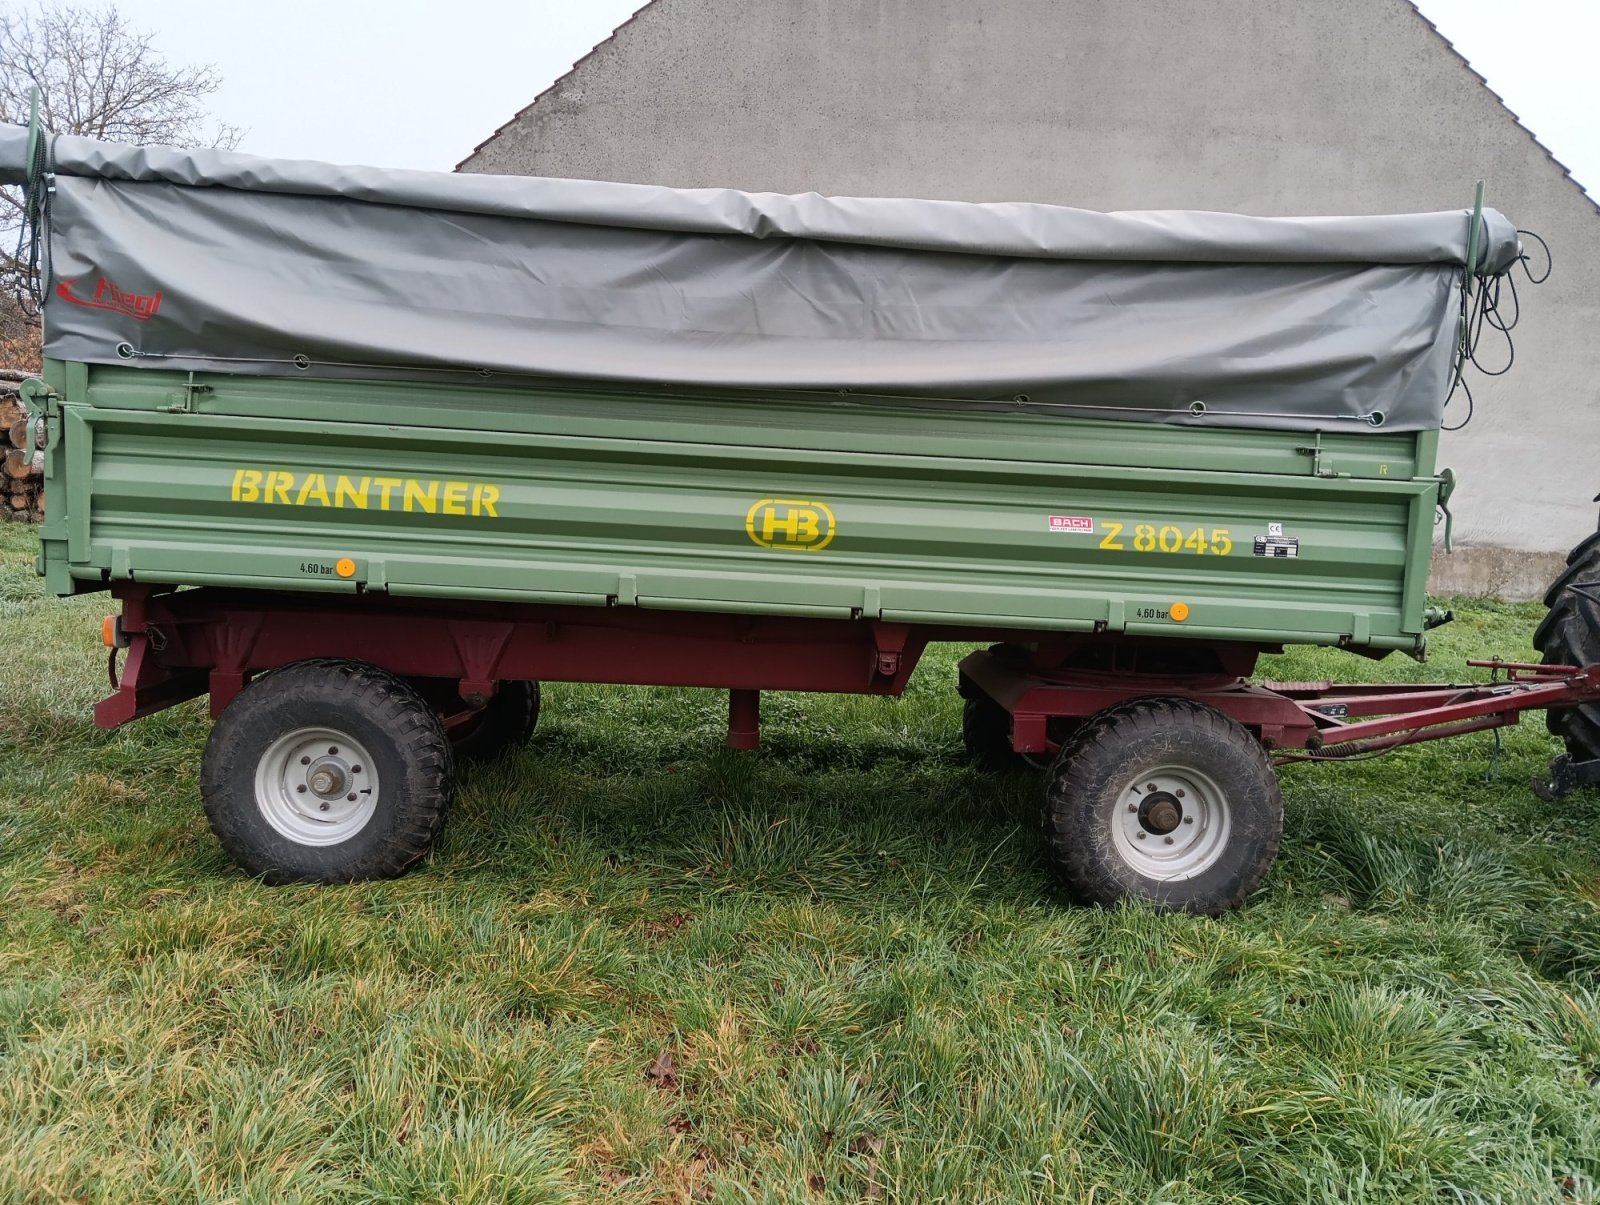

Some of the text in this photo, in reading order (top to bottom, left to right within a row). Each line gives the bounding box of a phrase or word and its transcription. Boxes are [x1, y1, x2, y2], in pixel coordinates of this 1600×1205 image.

[231, 469, 500, 517] BRANTNER
[763, 507, 819, 542] HB
[1053, 518, 1089, 528] BACH
[1100, 522, 1124, 550] Z
[1133, 524, 1232, 556] 8045
[300, 563, 333, 575] 4.60 bar
[1156, 609, 1169, 619] bar
